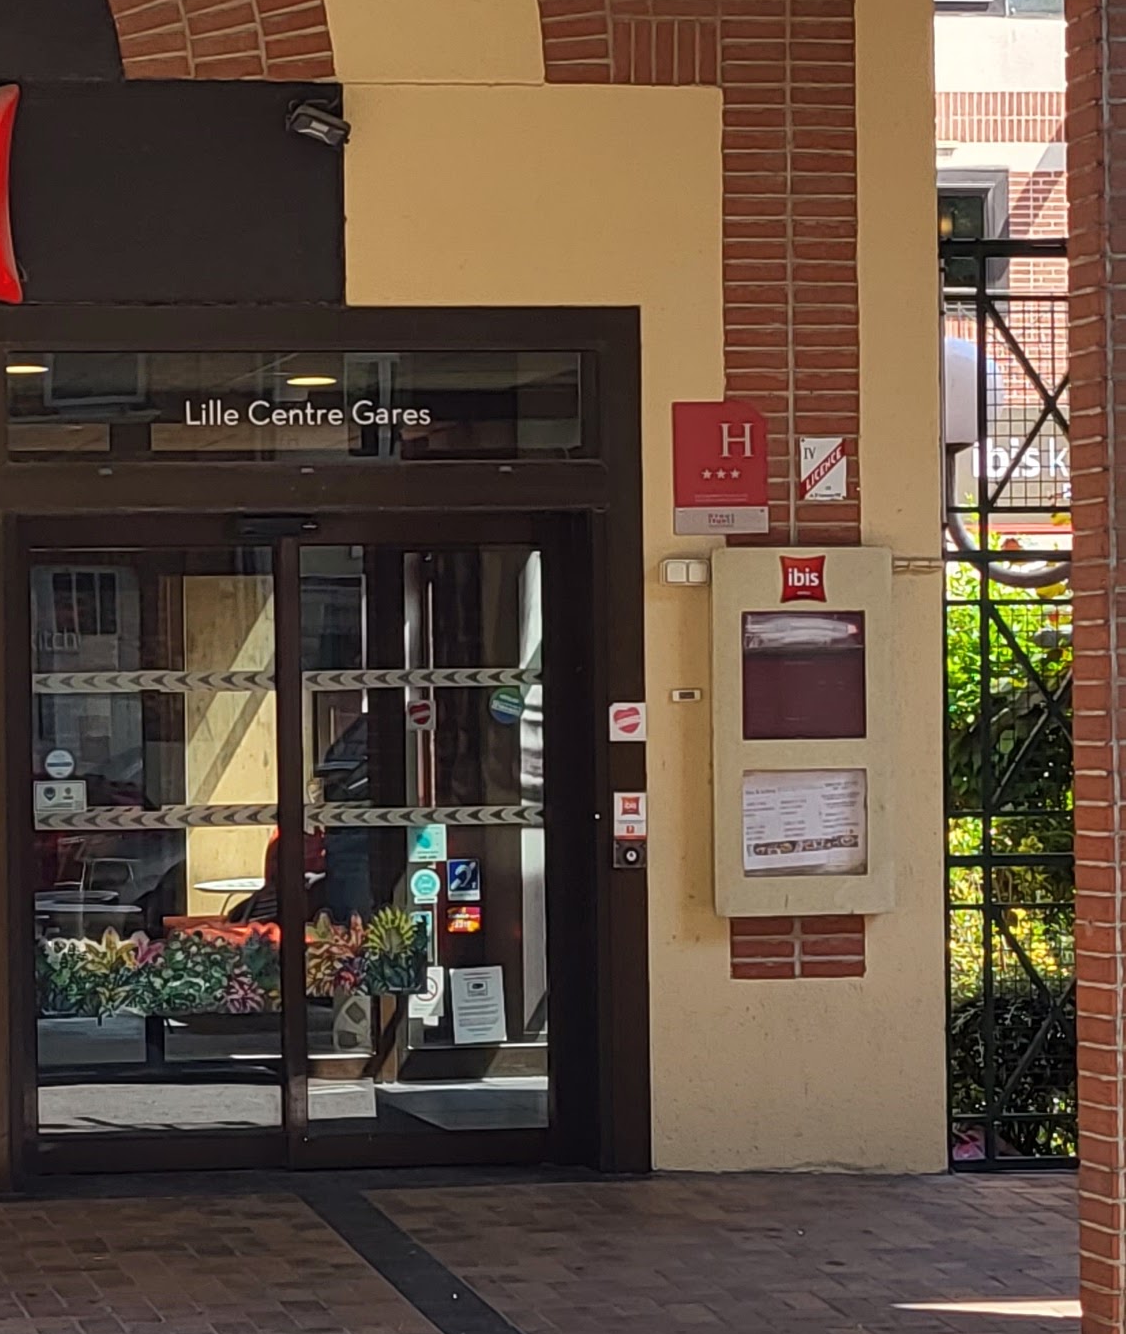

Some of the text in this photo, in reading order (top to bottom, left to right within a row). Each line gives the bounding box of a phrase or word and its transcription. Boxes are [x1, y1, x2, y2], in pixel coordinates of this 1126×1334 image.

[185, 399, 431, 426] Lille Centre Gares
[719, 422, 754, 458] H
[803, 447, 816, 460] IV
[805, 445, 843, 491] LICENCE
[788, 567, 819, 586] ibis
